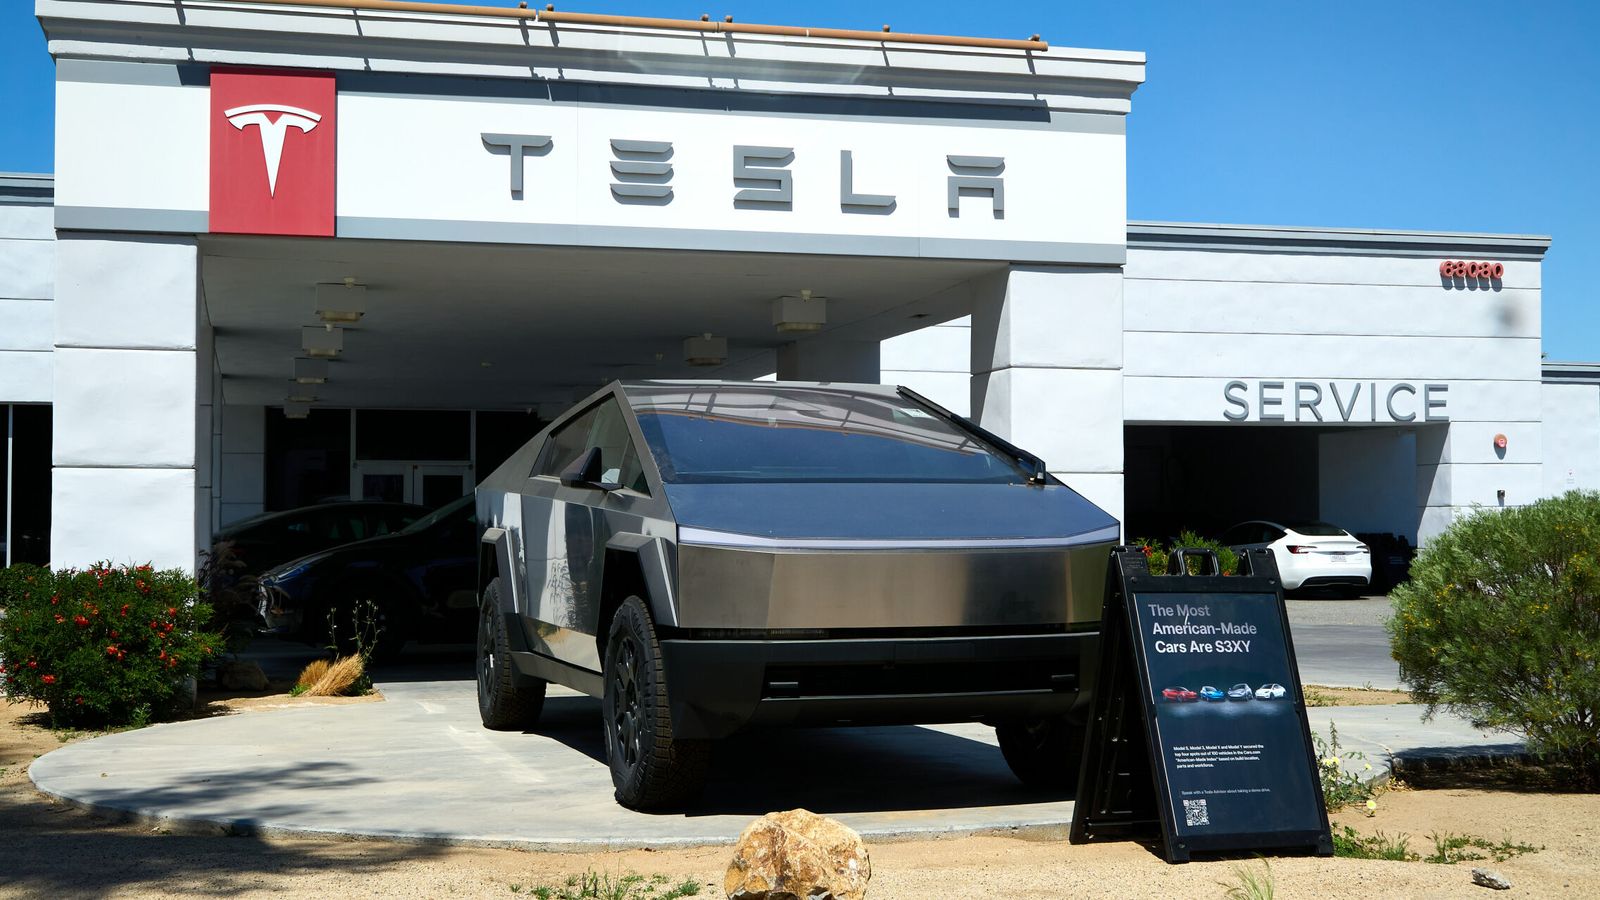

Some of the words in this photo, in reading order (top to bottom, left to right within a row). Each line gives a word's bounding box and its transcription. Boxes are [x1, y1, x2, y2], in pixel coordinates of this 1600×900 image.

[480, 132, 1006, 221] TESLA
[1223, 379, 1450, 423] SERVICE
[1147, 604, 1174, 617] The
[1177, 604, 1211, 617] Most
[1152, 622, 1257, 635] American-Made
[1155, 640, 1187, 654] Cars
[1190, 640, 1213, 653] Are
[1215, 639, 1251, 653] S3XY
